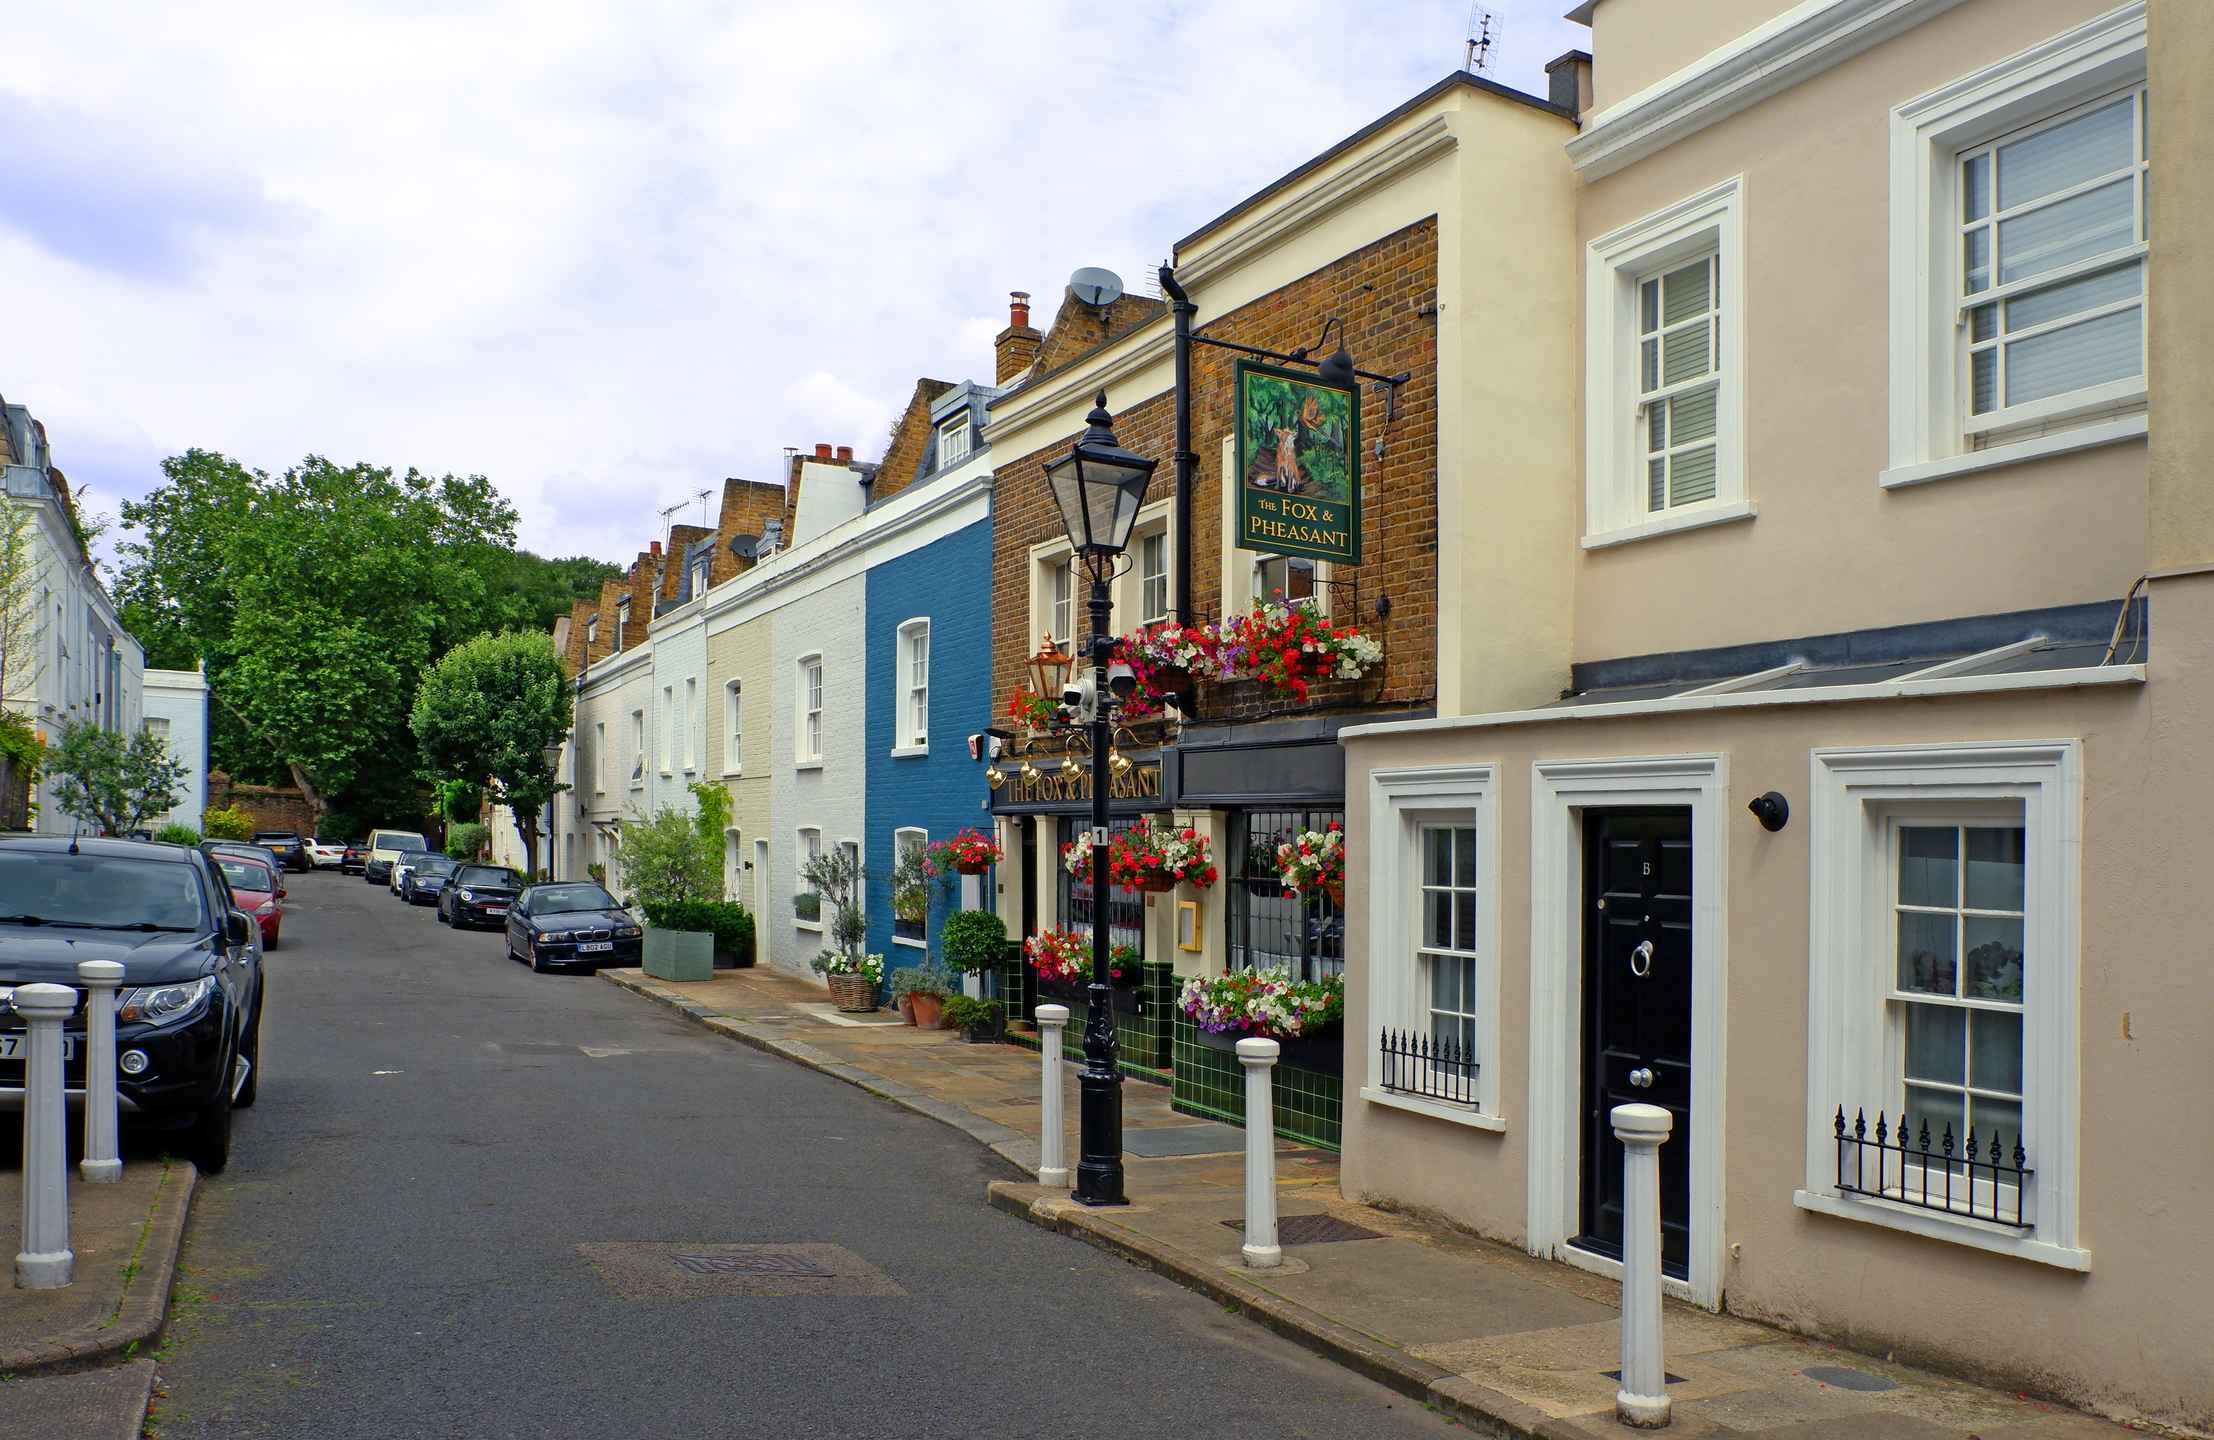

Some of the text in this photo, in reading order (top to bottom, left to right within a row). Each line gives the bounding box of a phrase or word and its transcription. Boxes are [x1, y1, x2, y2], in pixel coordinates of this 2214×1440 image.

[1322, 510, 1334, 522] &
[1096, 829, 1103, 844] 1
[1643, 862, 1650, 875] B
